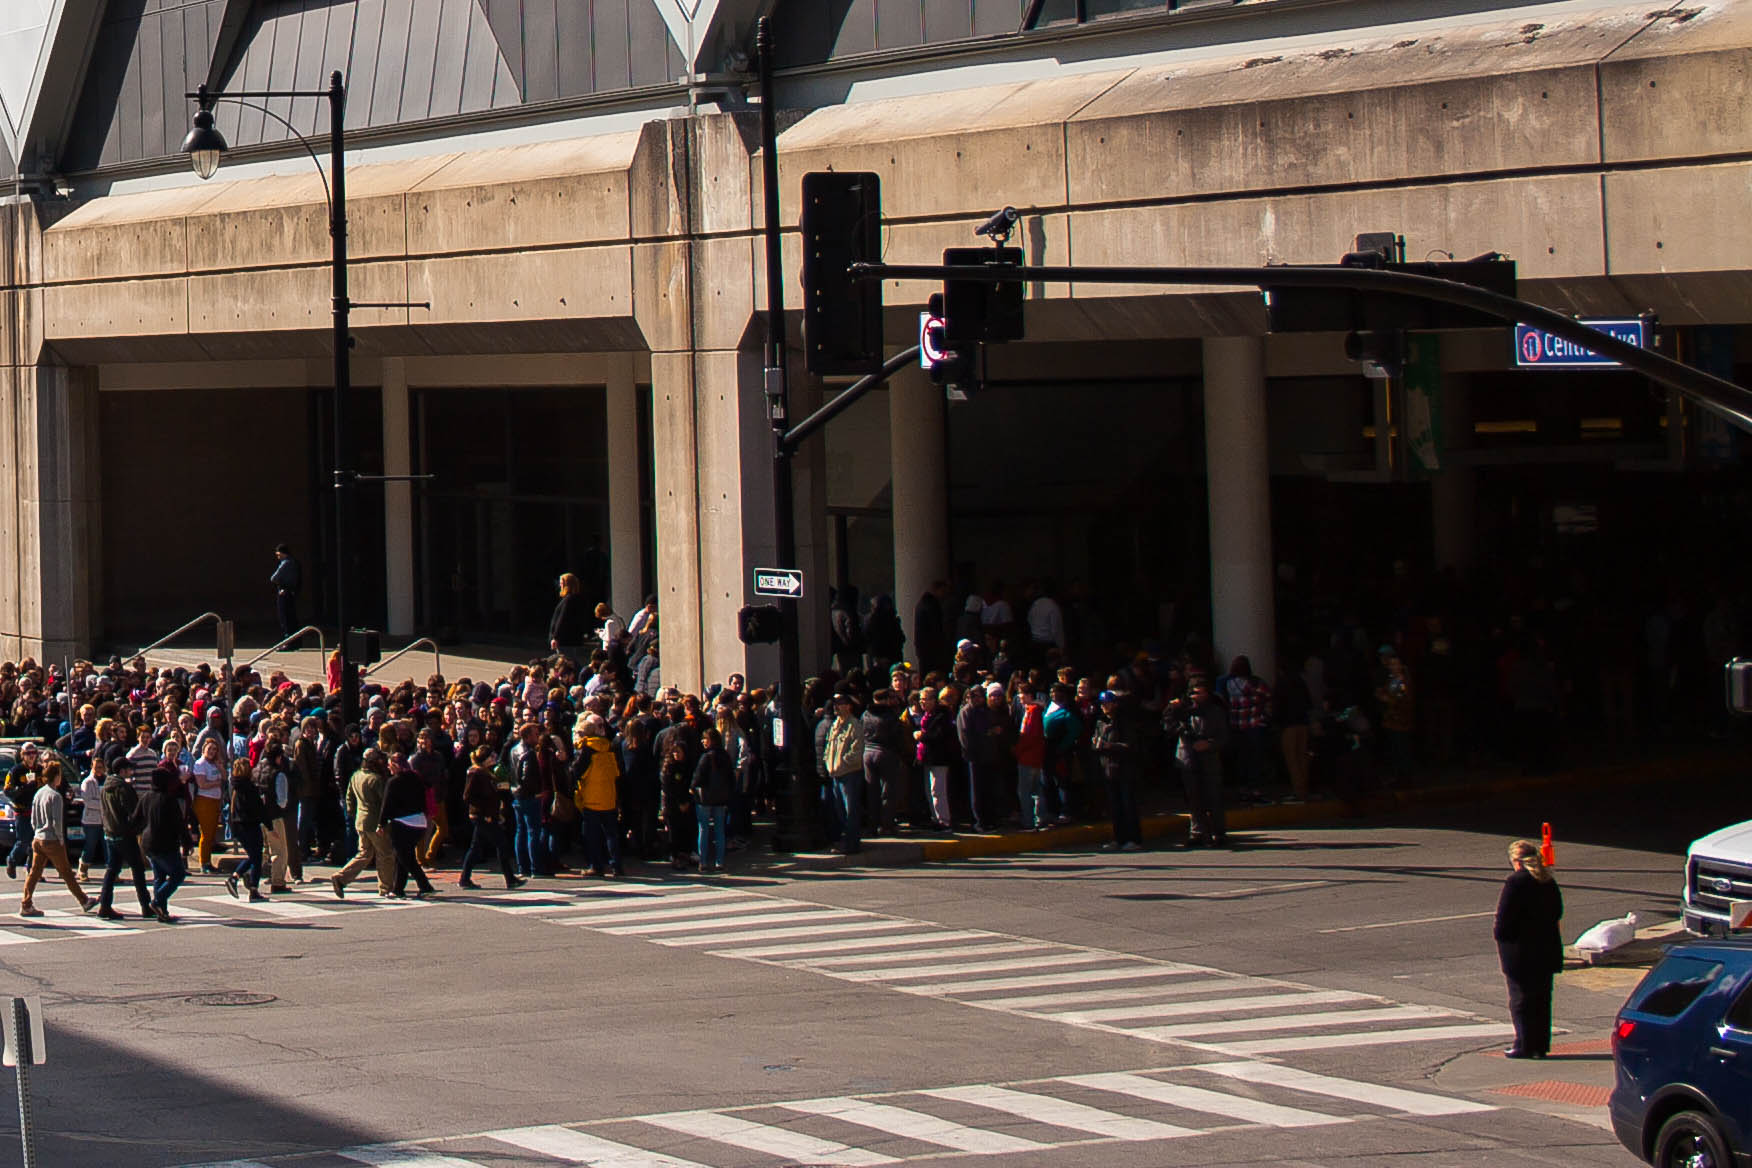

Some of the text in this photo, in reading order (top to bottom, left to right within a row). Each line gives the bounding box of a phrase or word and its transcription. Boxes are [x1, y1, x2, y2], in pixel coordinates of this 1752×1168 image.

[1544, 332, 1598, 356] Centr
[759, 576, 791, 588] ONE WAY
